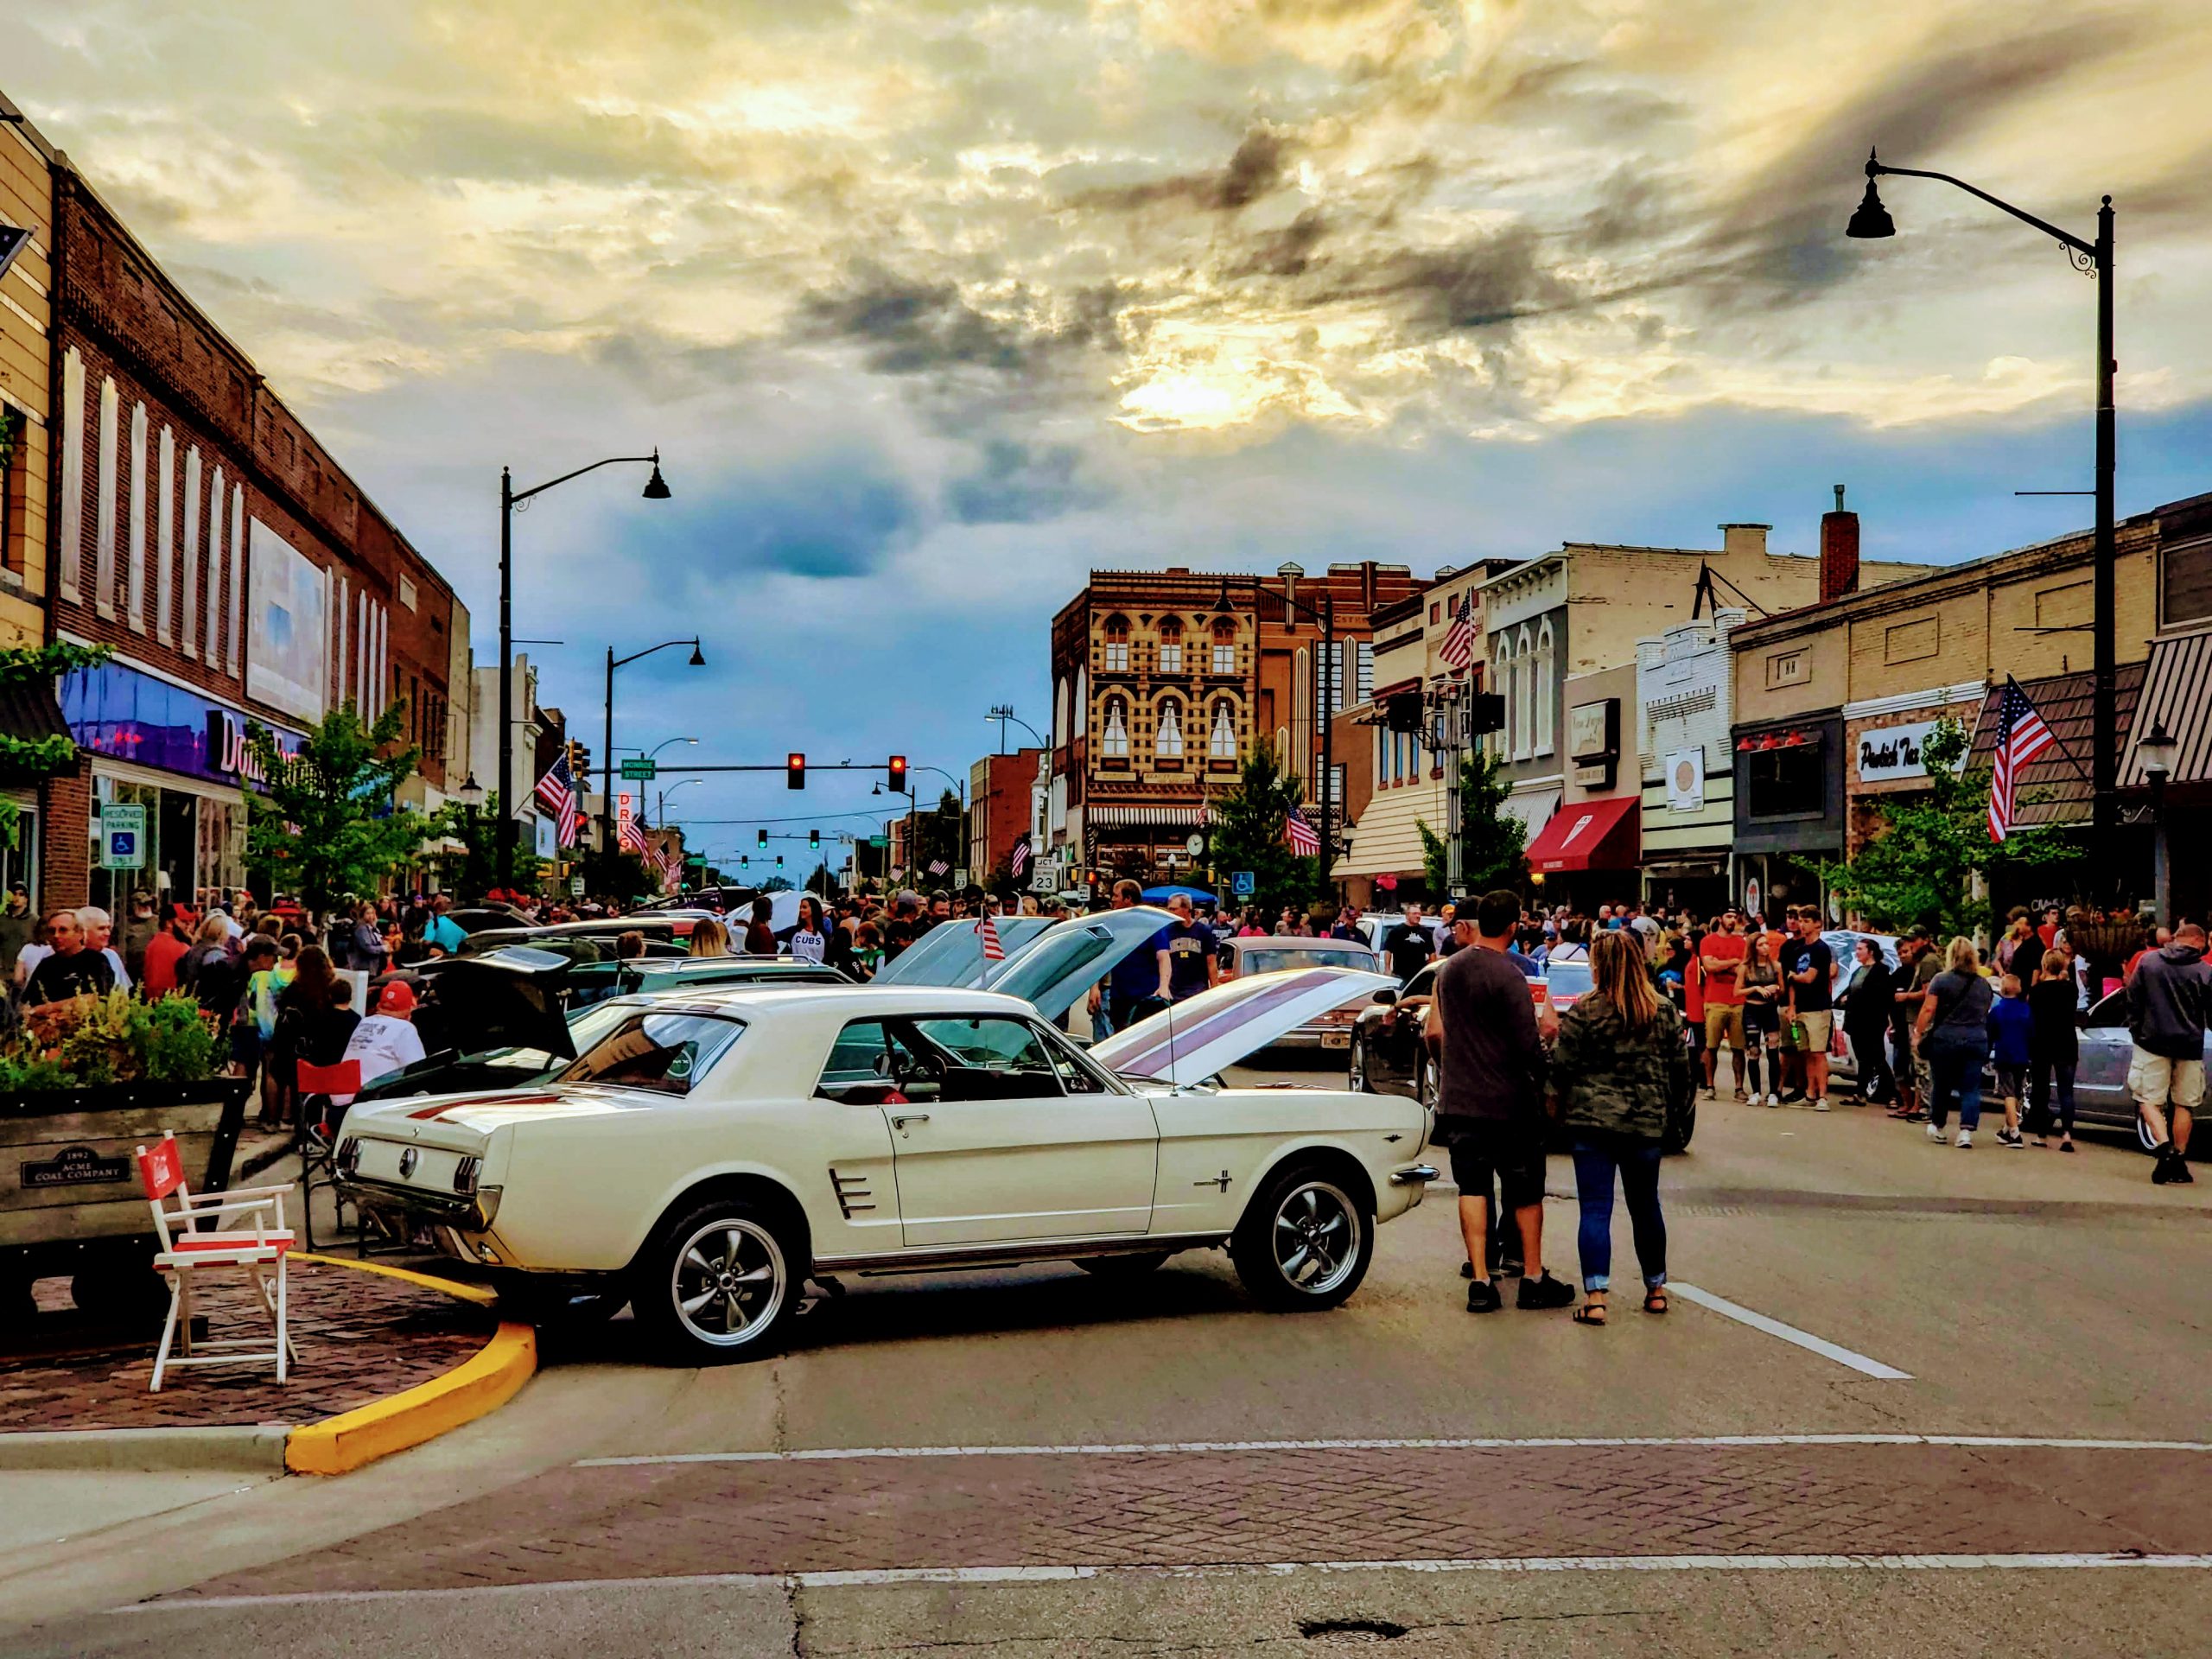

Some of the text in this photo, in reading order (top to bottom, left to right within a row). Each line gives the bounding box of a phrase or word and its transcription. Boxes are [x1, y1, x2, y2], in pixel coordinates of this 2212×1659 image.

[105, 821, 140, 830] PARKING
[620, 794, 630, 848] DRUG
[111, 856, 133, 865] ONLY
[1037, 877, 1052, 888] 23
[795, 936, 822, 946] CUBS
[67, 1152, 89, 1160] 1892
[62, 1162, 92, 1172] ACME
[35, 1168, 120, 1182] COAL COMPANY
